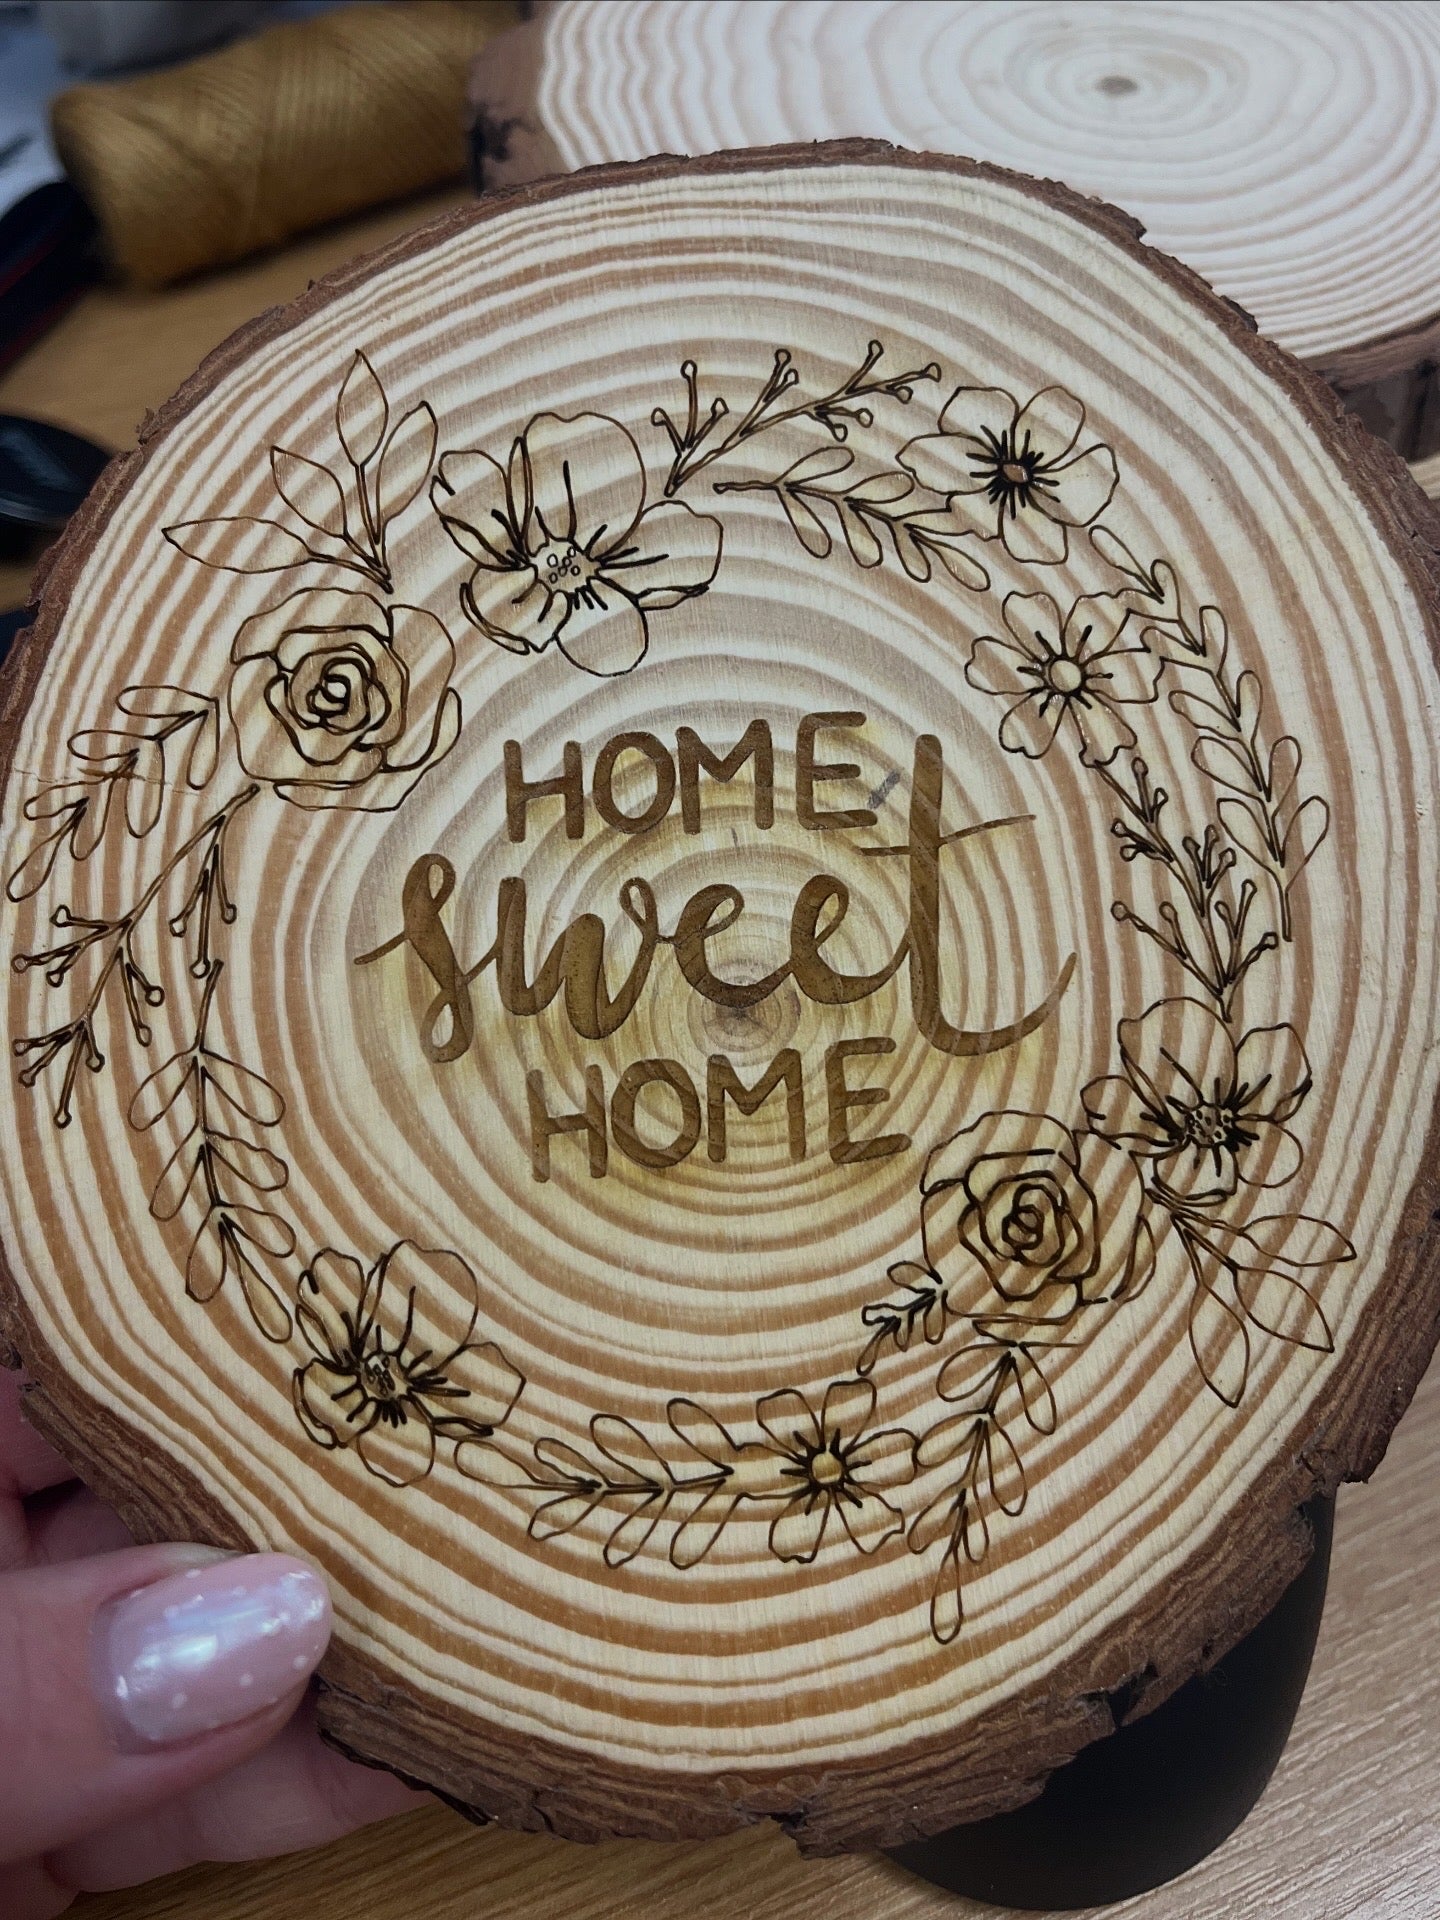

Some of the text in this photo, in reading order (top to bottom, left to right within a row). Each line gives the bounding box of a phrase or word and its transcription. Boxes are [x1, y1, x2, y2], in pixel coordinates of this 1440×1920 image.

[503, 711, 878, 843] HOME
[354, 734, 1077, 1064] sweet
[527, 1037, 912, 1183] HOME
